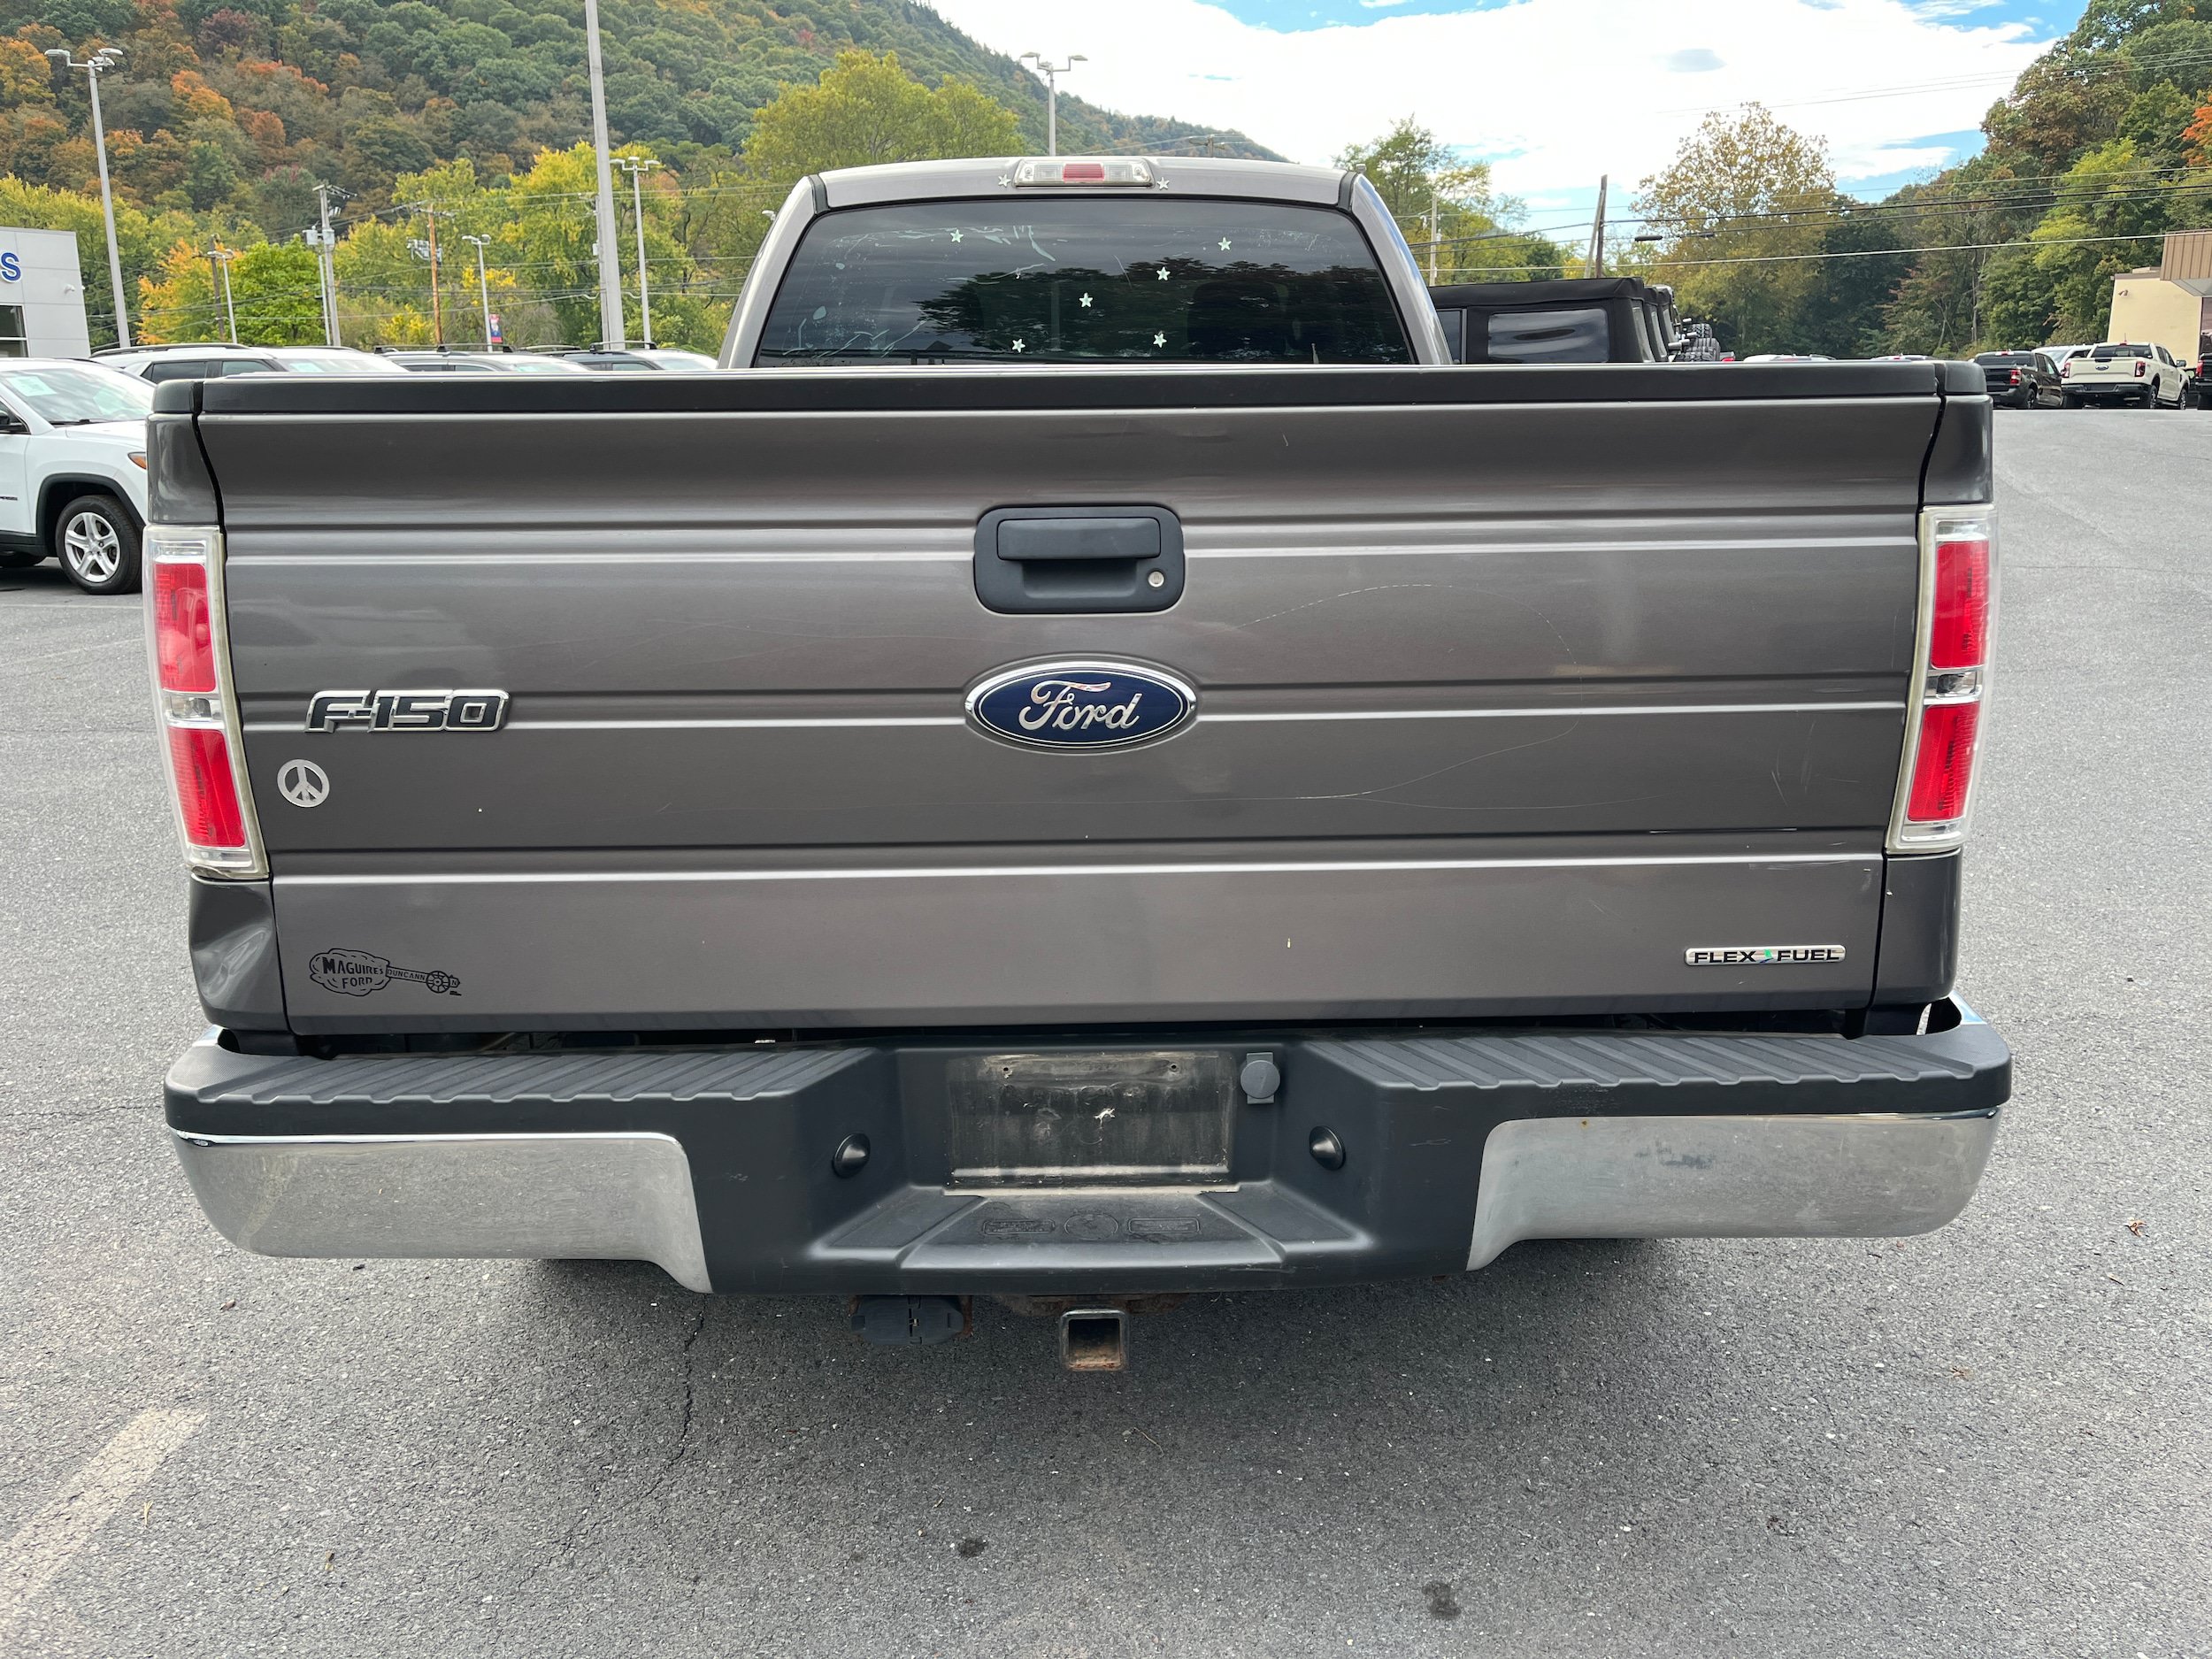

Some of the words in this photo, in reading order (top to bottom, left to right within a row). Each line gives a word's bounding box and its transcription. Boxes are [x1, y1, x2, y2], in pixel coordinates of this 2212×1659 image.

[304, 689, 510, 733] F-150
[1018, 680, 1143, 731] Ford
[322, 956, 384, 975] MAGUIRES
[1694, 950, 1757, 964] FLEX
[1776, 949, 1840, 962] FUEL
[342, 977, 373, 989] FORD
